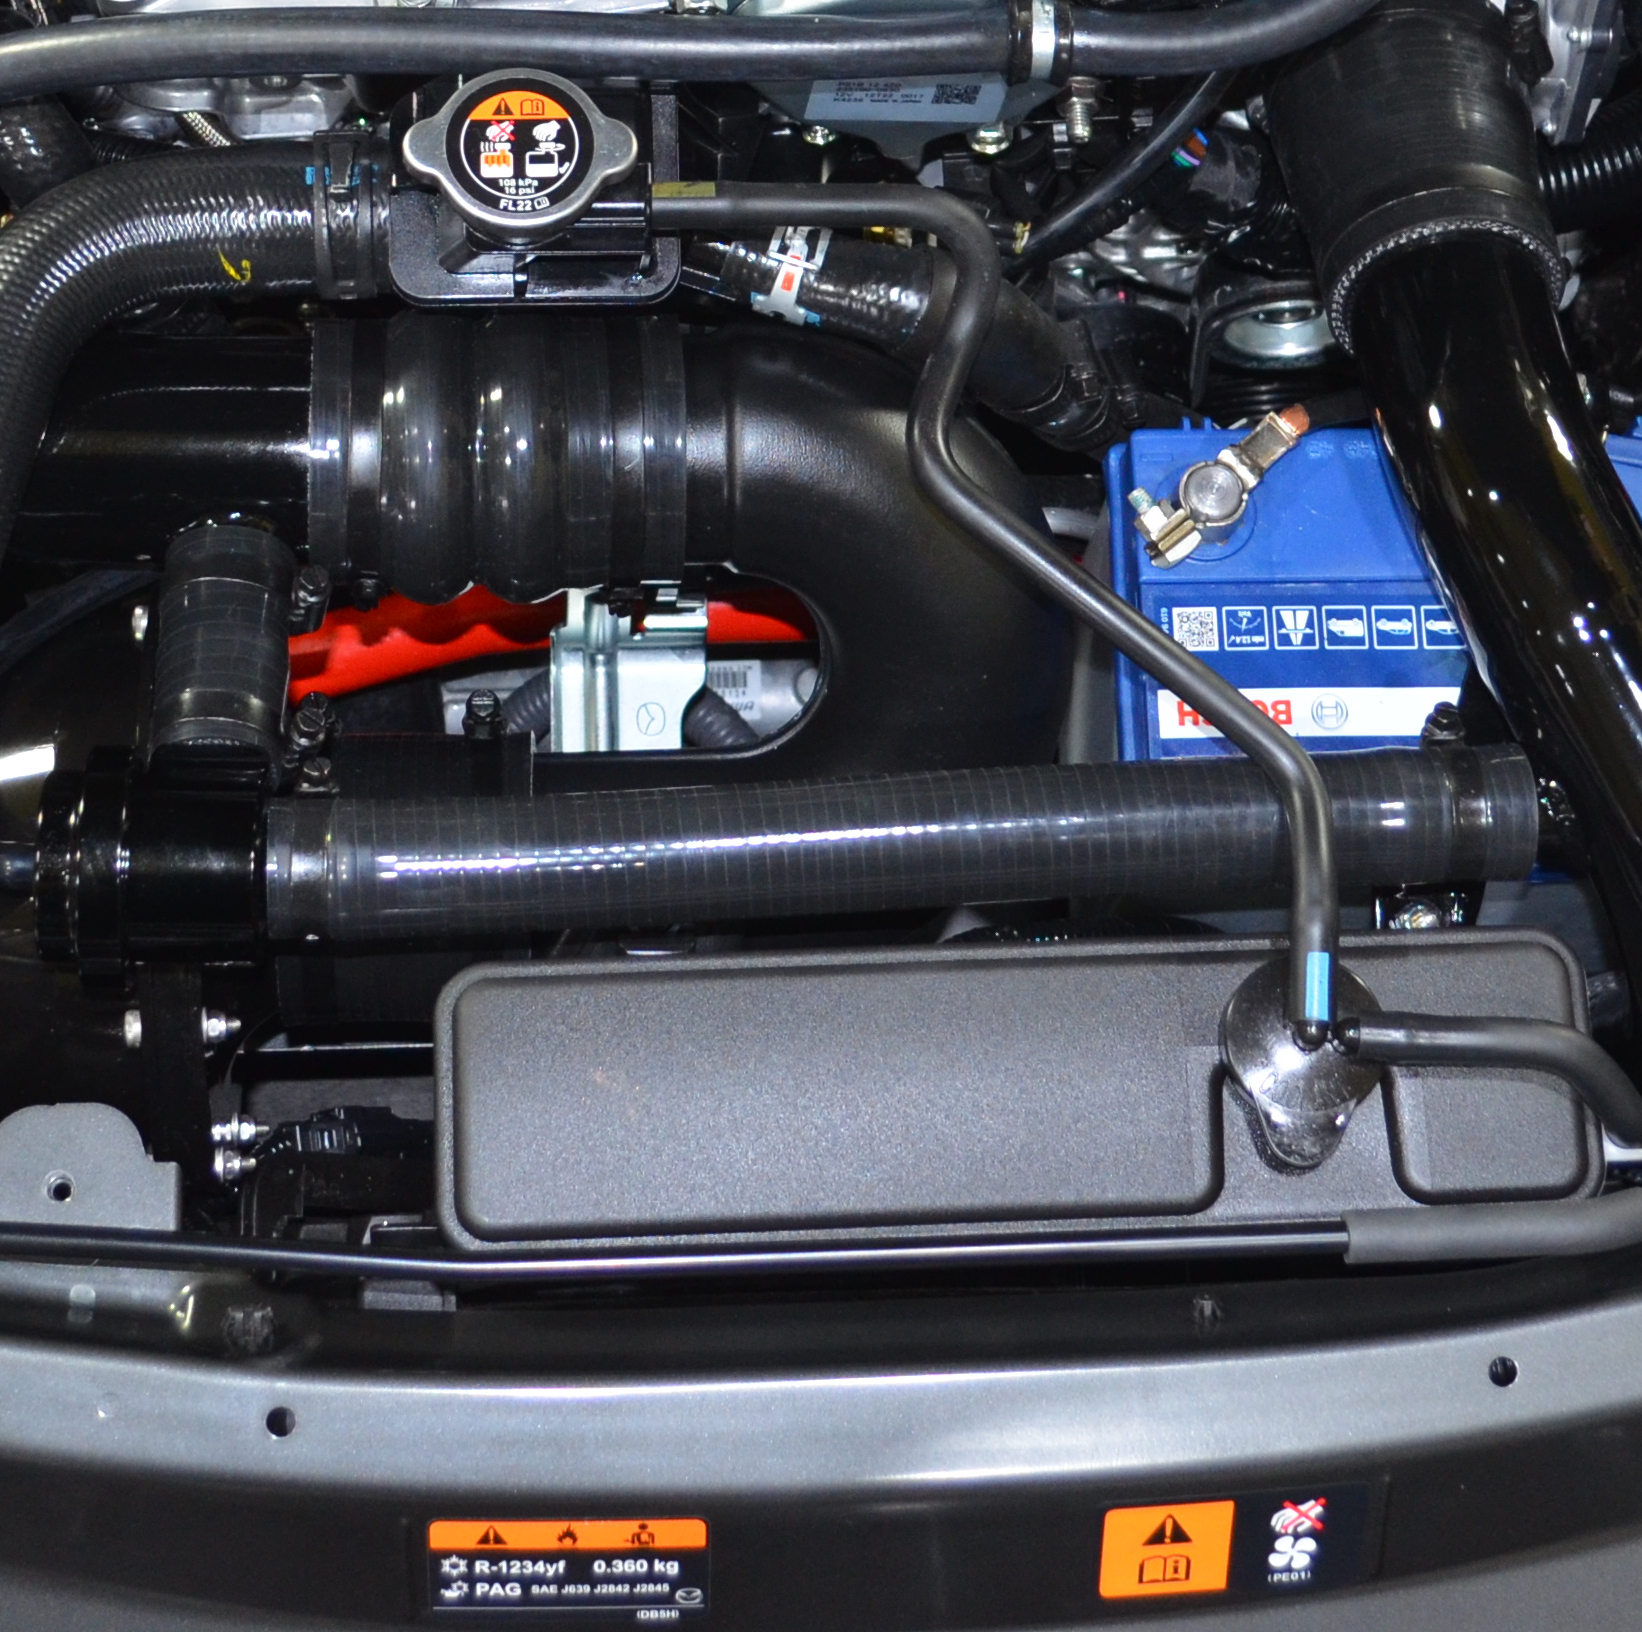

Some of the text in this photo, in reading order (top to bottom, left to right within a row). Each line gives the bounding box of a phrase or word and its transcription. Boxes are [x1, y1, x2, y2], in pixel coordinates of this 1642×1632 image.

[498, 178, 538, 187] 108 kPa
[504, 186, 535, 196] 16 psi
[499, 198, 533, 211] FL22
[475, 1558, 679, 1576] R-1234yf 0.360 kg
[1268, 1570, 1311, 1583] (PE01)
[476, 1581, 522, 1597] PAG
[531, 1584, 558, 1595] SAE
[561, 1584, 591, 1595] J639
